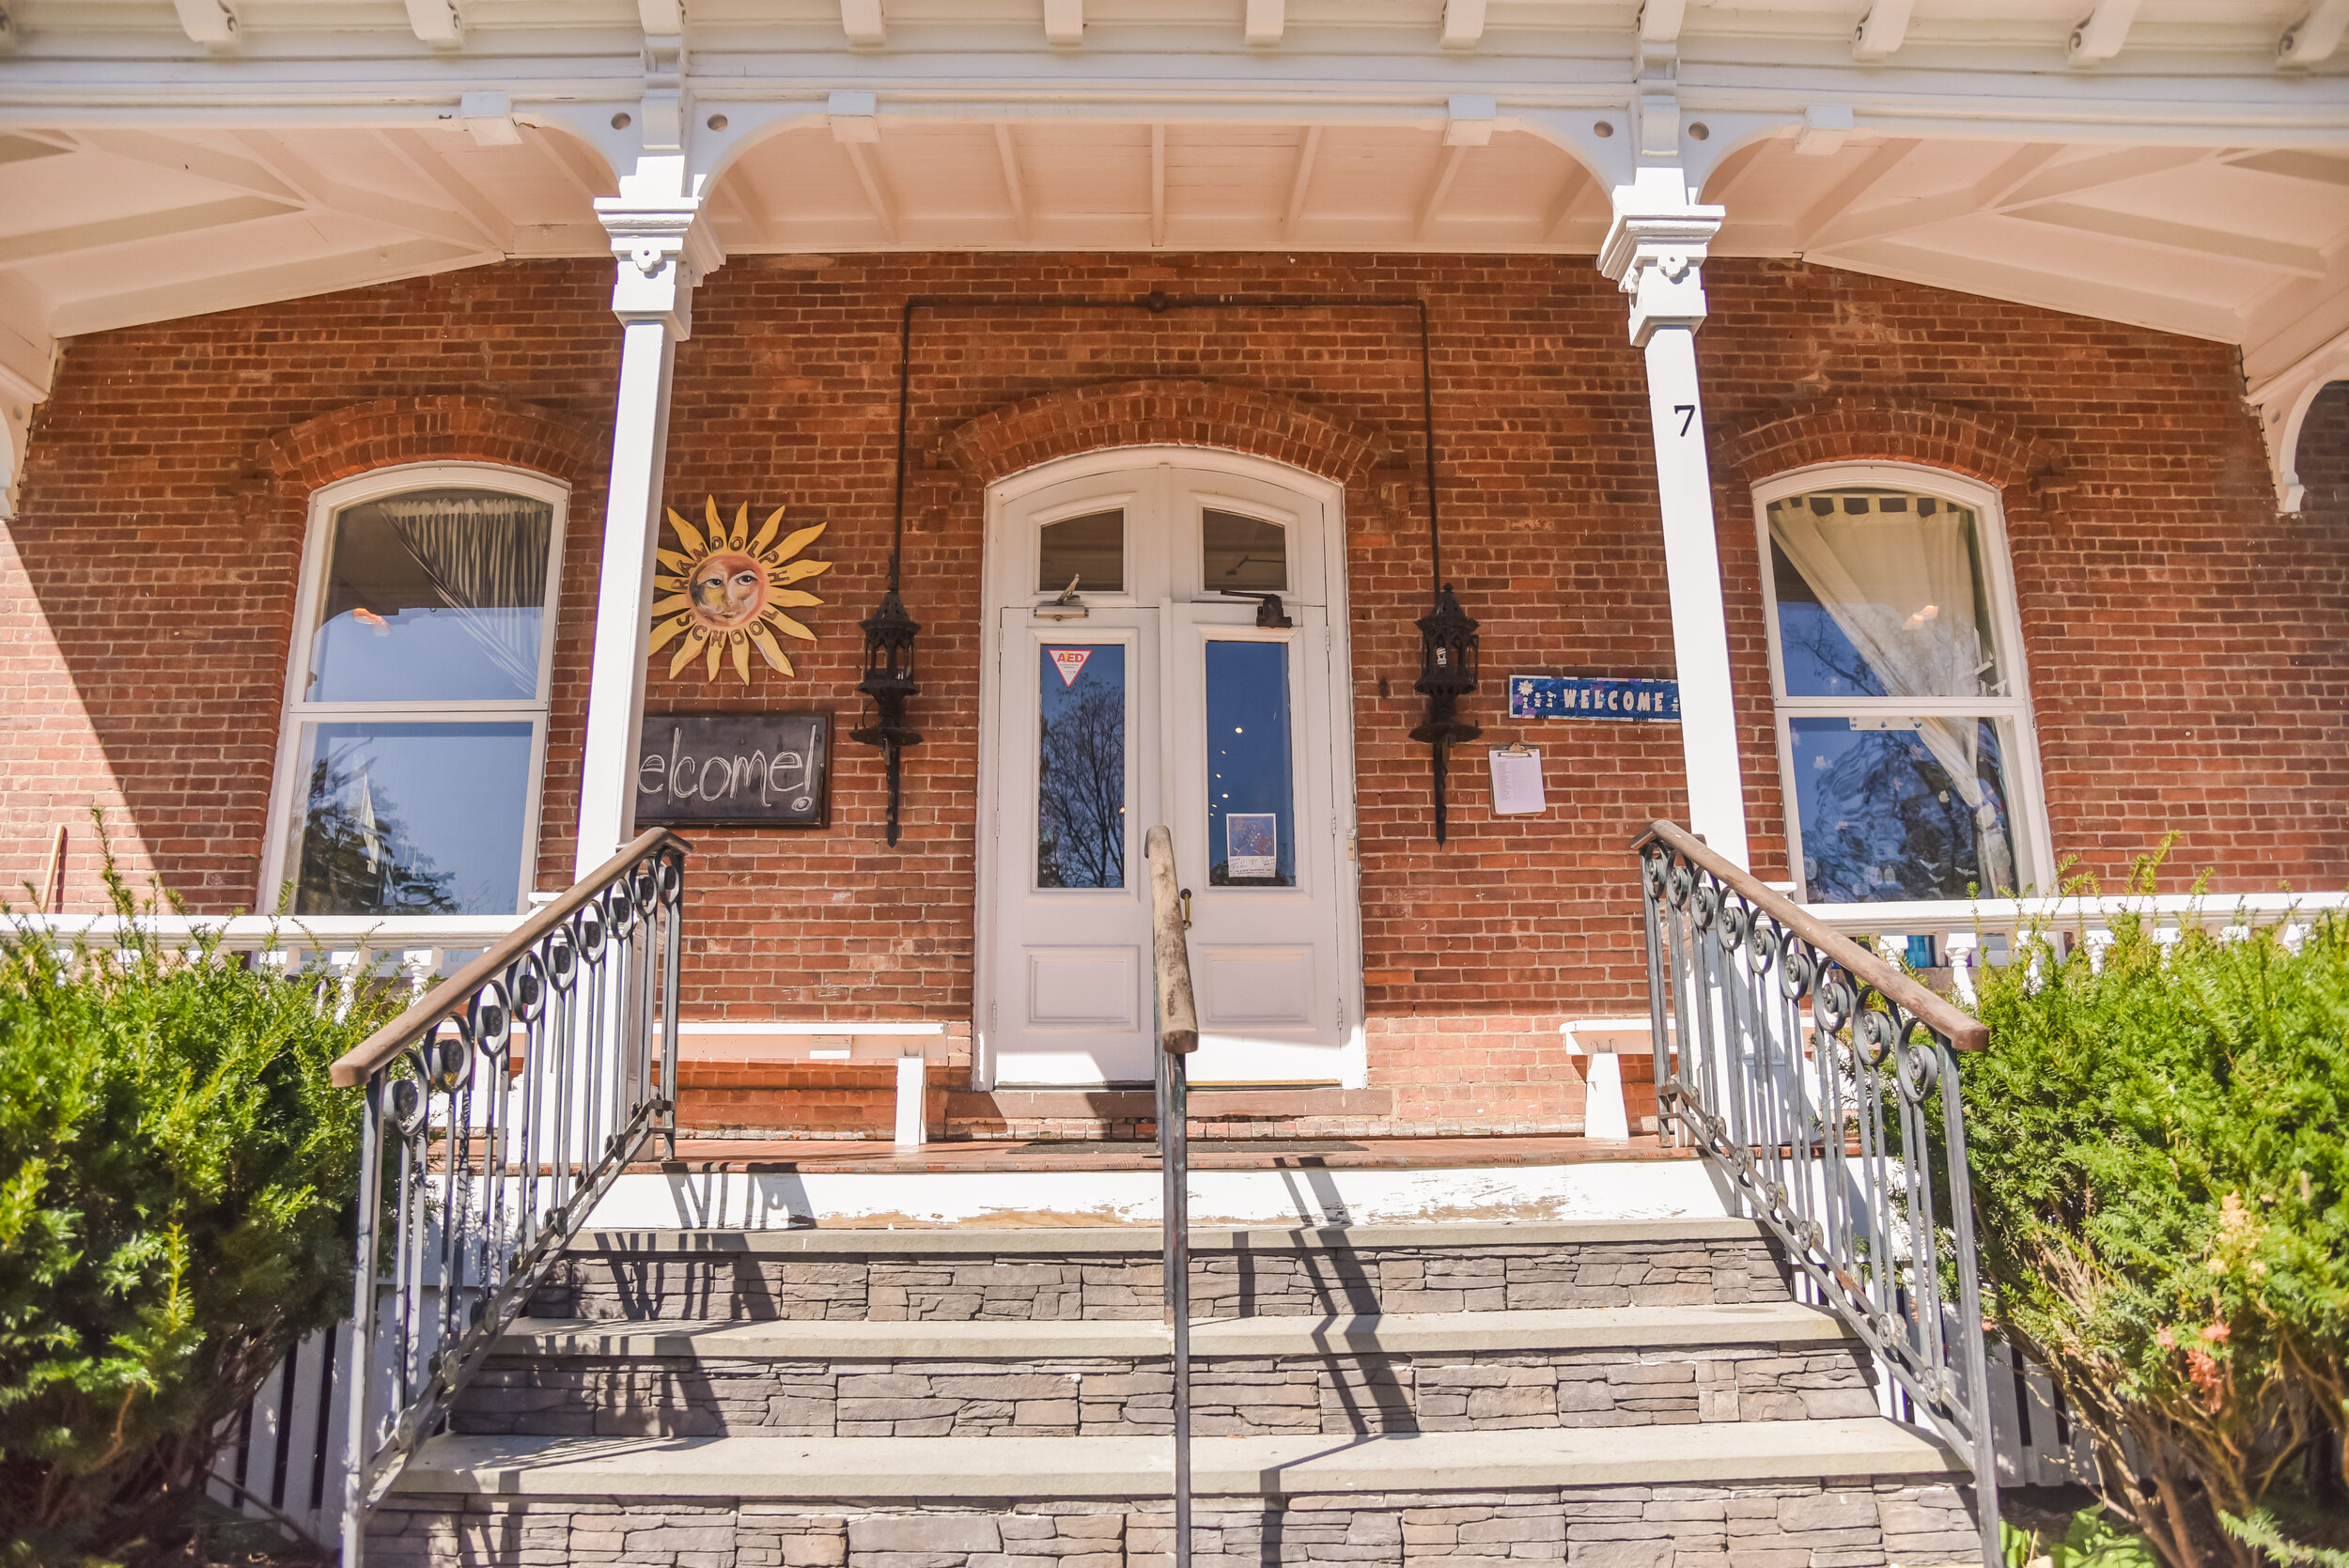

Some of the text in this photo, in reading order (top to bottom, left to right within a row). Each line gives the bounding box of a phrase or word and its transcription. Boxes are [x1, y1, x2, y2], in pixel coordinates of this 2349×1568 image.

[1673, 405, 1695, 438] 7
[671, 536, 790, 590] RANDOLPH
[676, 609, 780, 648] SCHOOL
[1056, 653, 1084, 663] AED
[1563, 689, 1664, 712] WELCOME
[638, 724, 817, 812] elcome!
